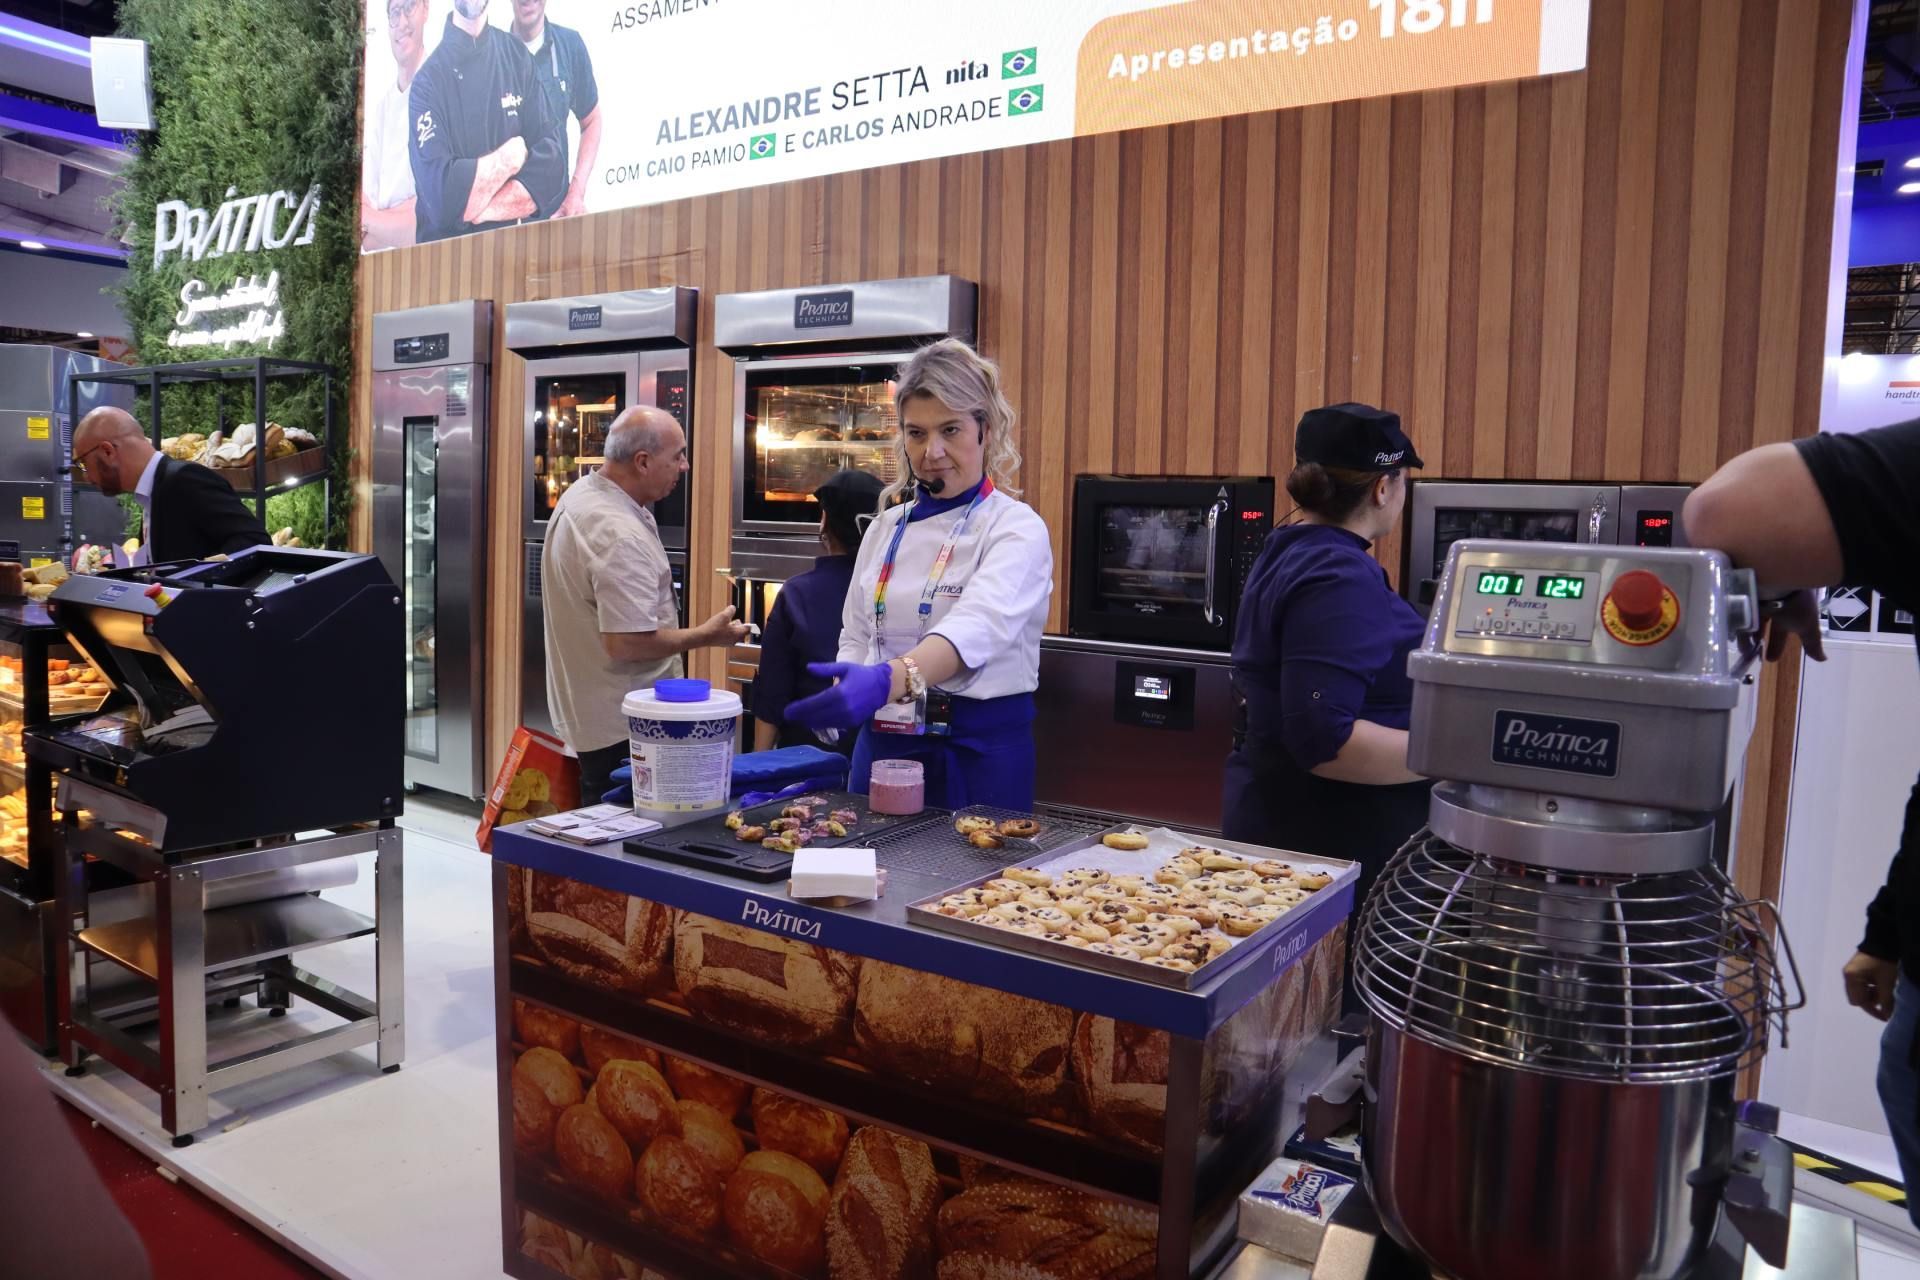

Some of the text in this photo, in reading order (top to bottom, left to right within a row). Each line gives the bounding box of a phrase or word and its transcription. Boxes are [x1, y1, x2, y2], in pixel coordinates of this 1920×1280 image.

[1107, 16, 1358, 81] Apresentação
[655, 60, 989, 145] ALEXANDRE SETTA nita
[606, 96, 1002, 186] COM CAIO PAMIO E CARLOS ANDRADE
[1479, 575, 1523, 594] 001
[1503, 719, 1609, 755] PRÁTICA
[1503, 746, 1608, 768] TECHNIPAN
[741, 898, 822, 939] PRÁTICA
